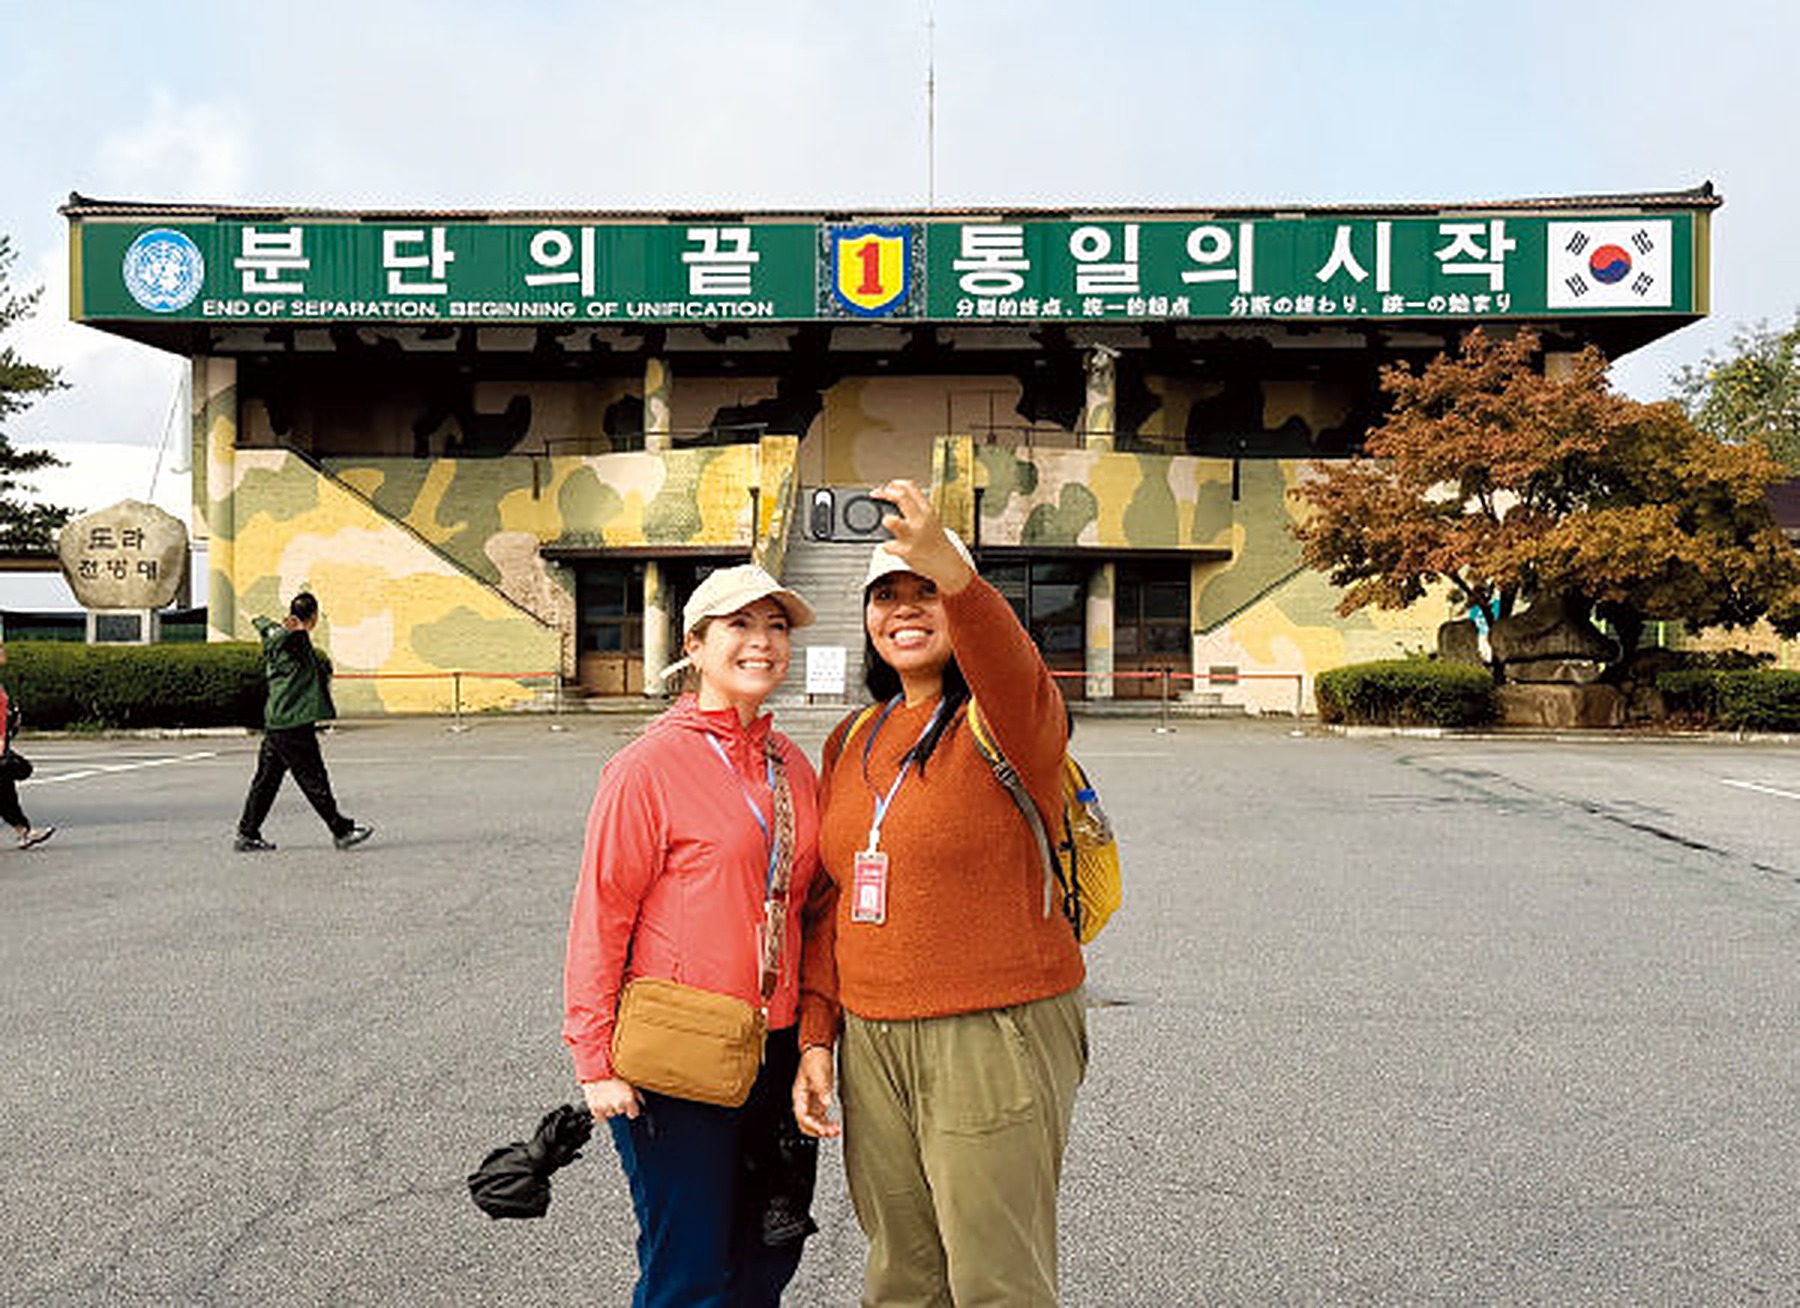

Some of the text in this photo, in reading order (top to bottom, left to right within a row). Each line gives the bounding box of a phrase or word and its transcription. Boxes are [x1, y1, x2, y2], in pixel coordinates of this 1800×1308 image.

[855, 241, 884, 296] 1
[202, 301, 774, 318] END OF SEPARATION, BEGINNING OF UNIFICATION
[88, 526, 146, 551] 도라
[78, 558, 158, 581] 전망대
